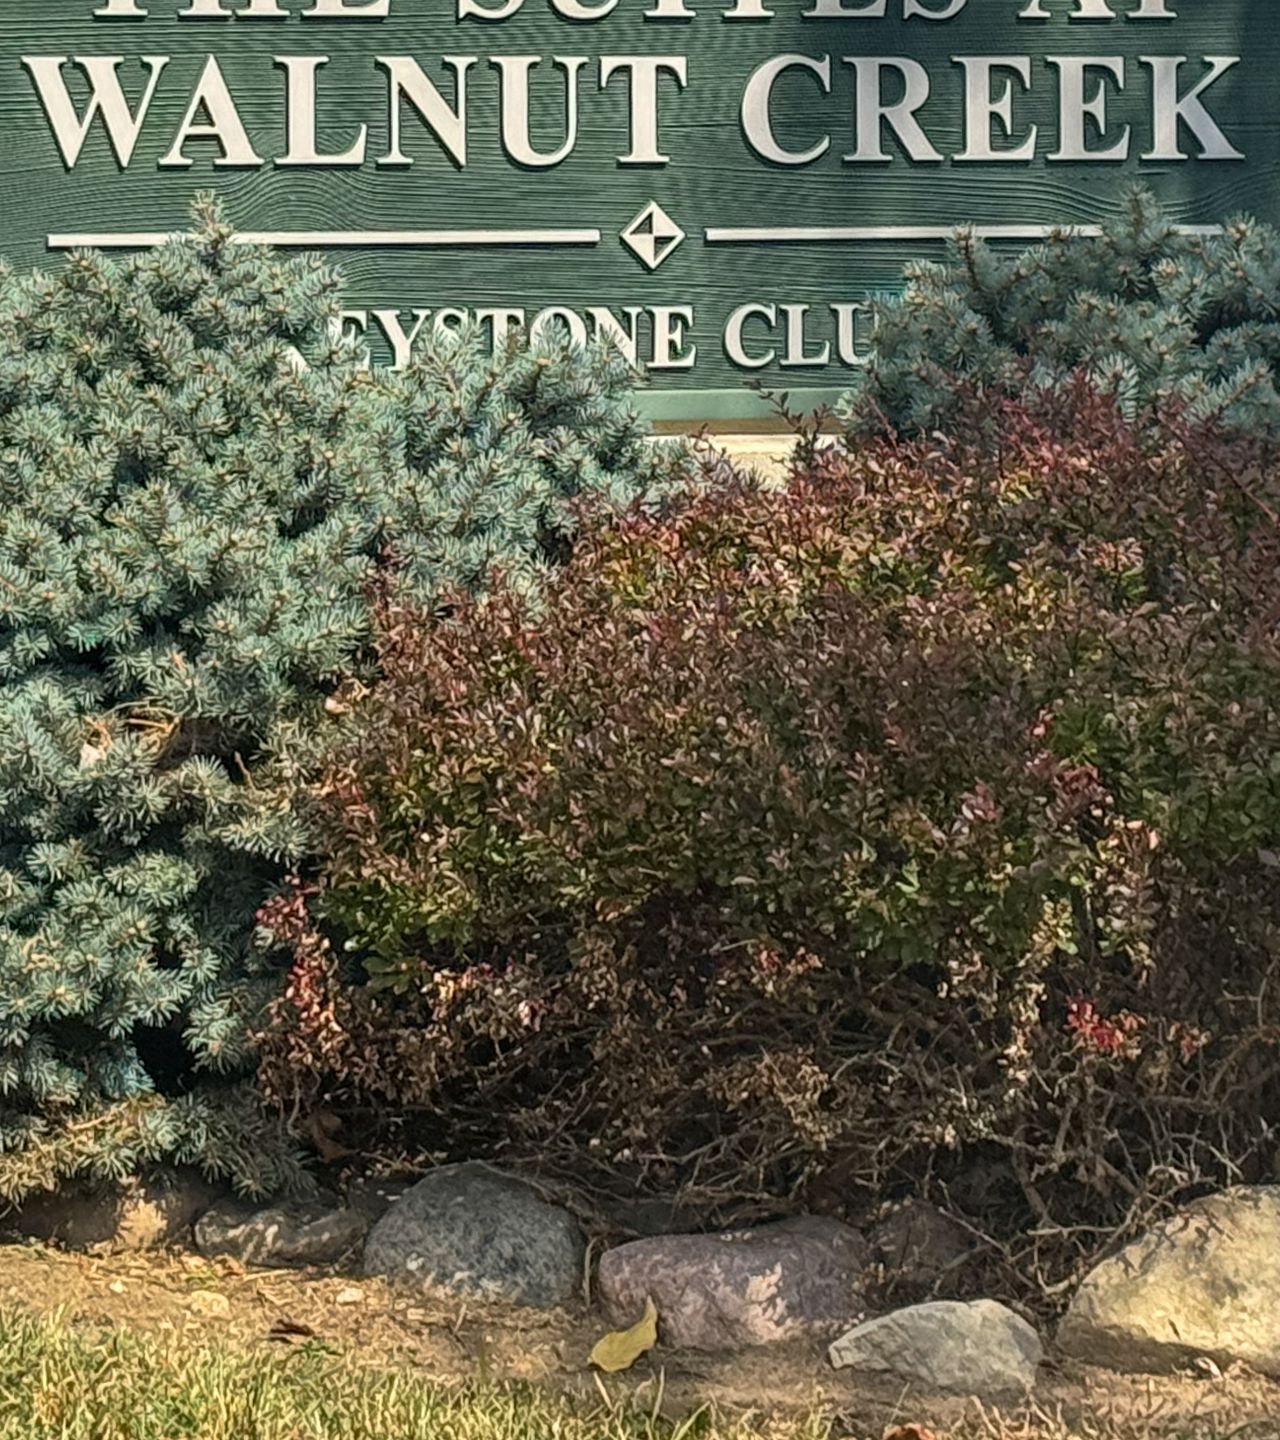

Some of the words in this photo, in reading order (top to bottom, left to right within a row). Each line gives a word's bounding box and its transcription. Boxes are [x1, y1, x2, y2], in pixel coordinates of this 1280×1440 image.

[20, 53, 688, 170] WALNUT
[740, 53, 1246, 166] CREEK
[282, 305, 697, 373] EYSTONE
[723, 303, 880, 369] CLU
